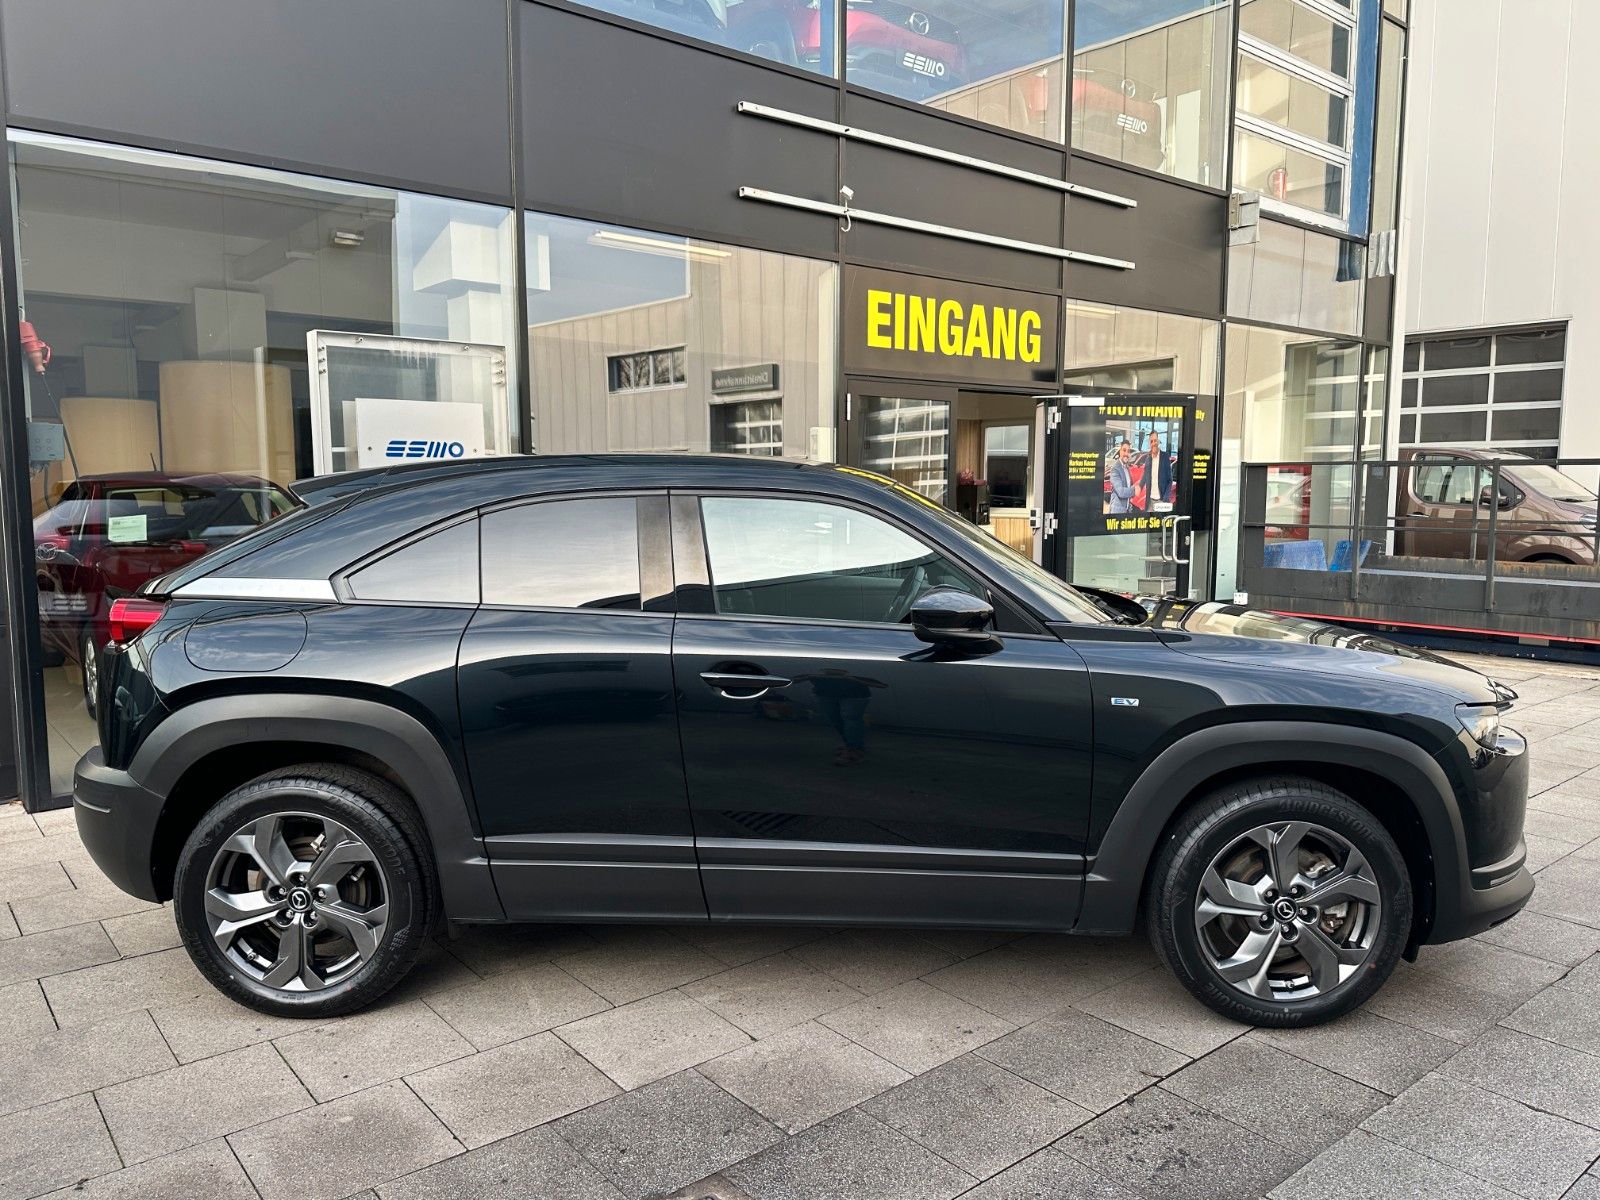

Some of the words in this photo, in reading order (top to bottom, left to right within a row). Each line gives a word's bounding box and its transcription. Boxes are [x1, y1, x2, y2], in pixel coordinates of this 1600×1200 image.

[903, 52, 944, 76] ESMO
[1117, 113, 1147, 132] ESMO
[867, 289, 1042, 363] EINGANG
[386, 440, 464, 458] ESMO
[1106, 518, 1119, 530] Wir
[1120, 517, 1136, 530] sind
[1137, 517, 1148, 529] für
[1149, 516, 1161, 528] Sie
[1162, 517, 1173, 528] a!
[1113, 698, 1138, 706] EV
